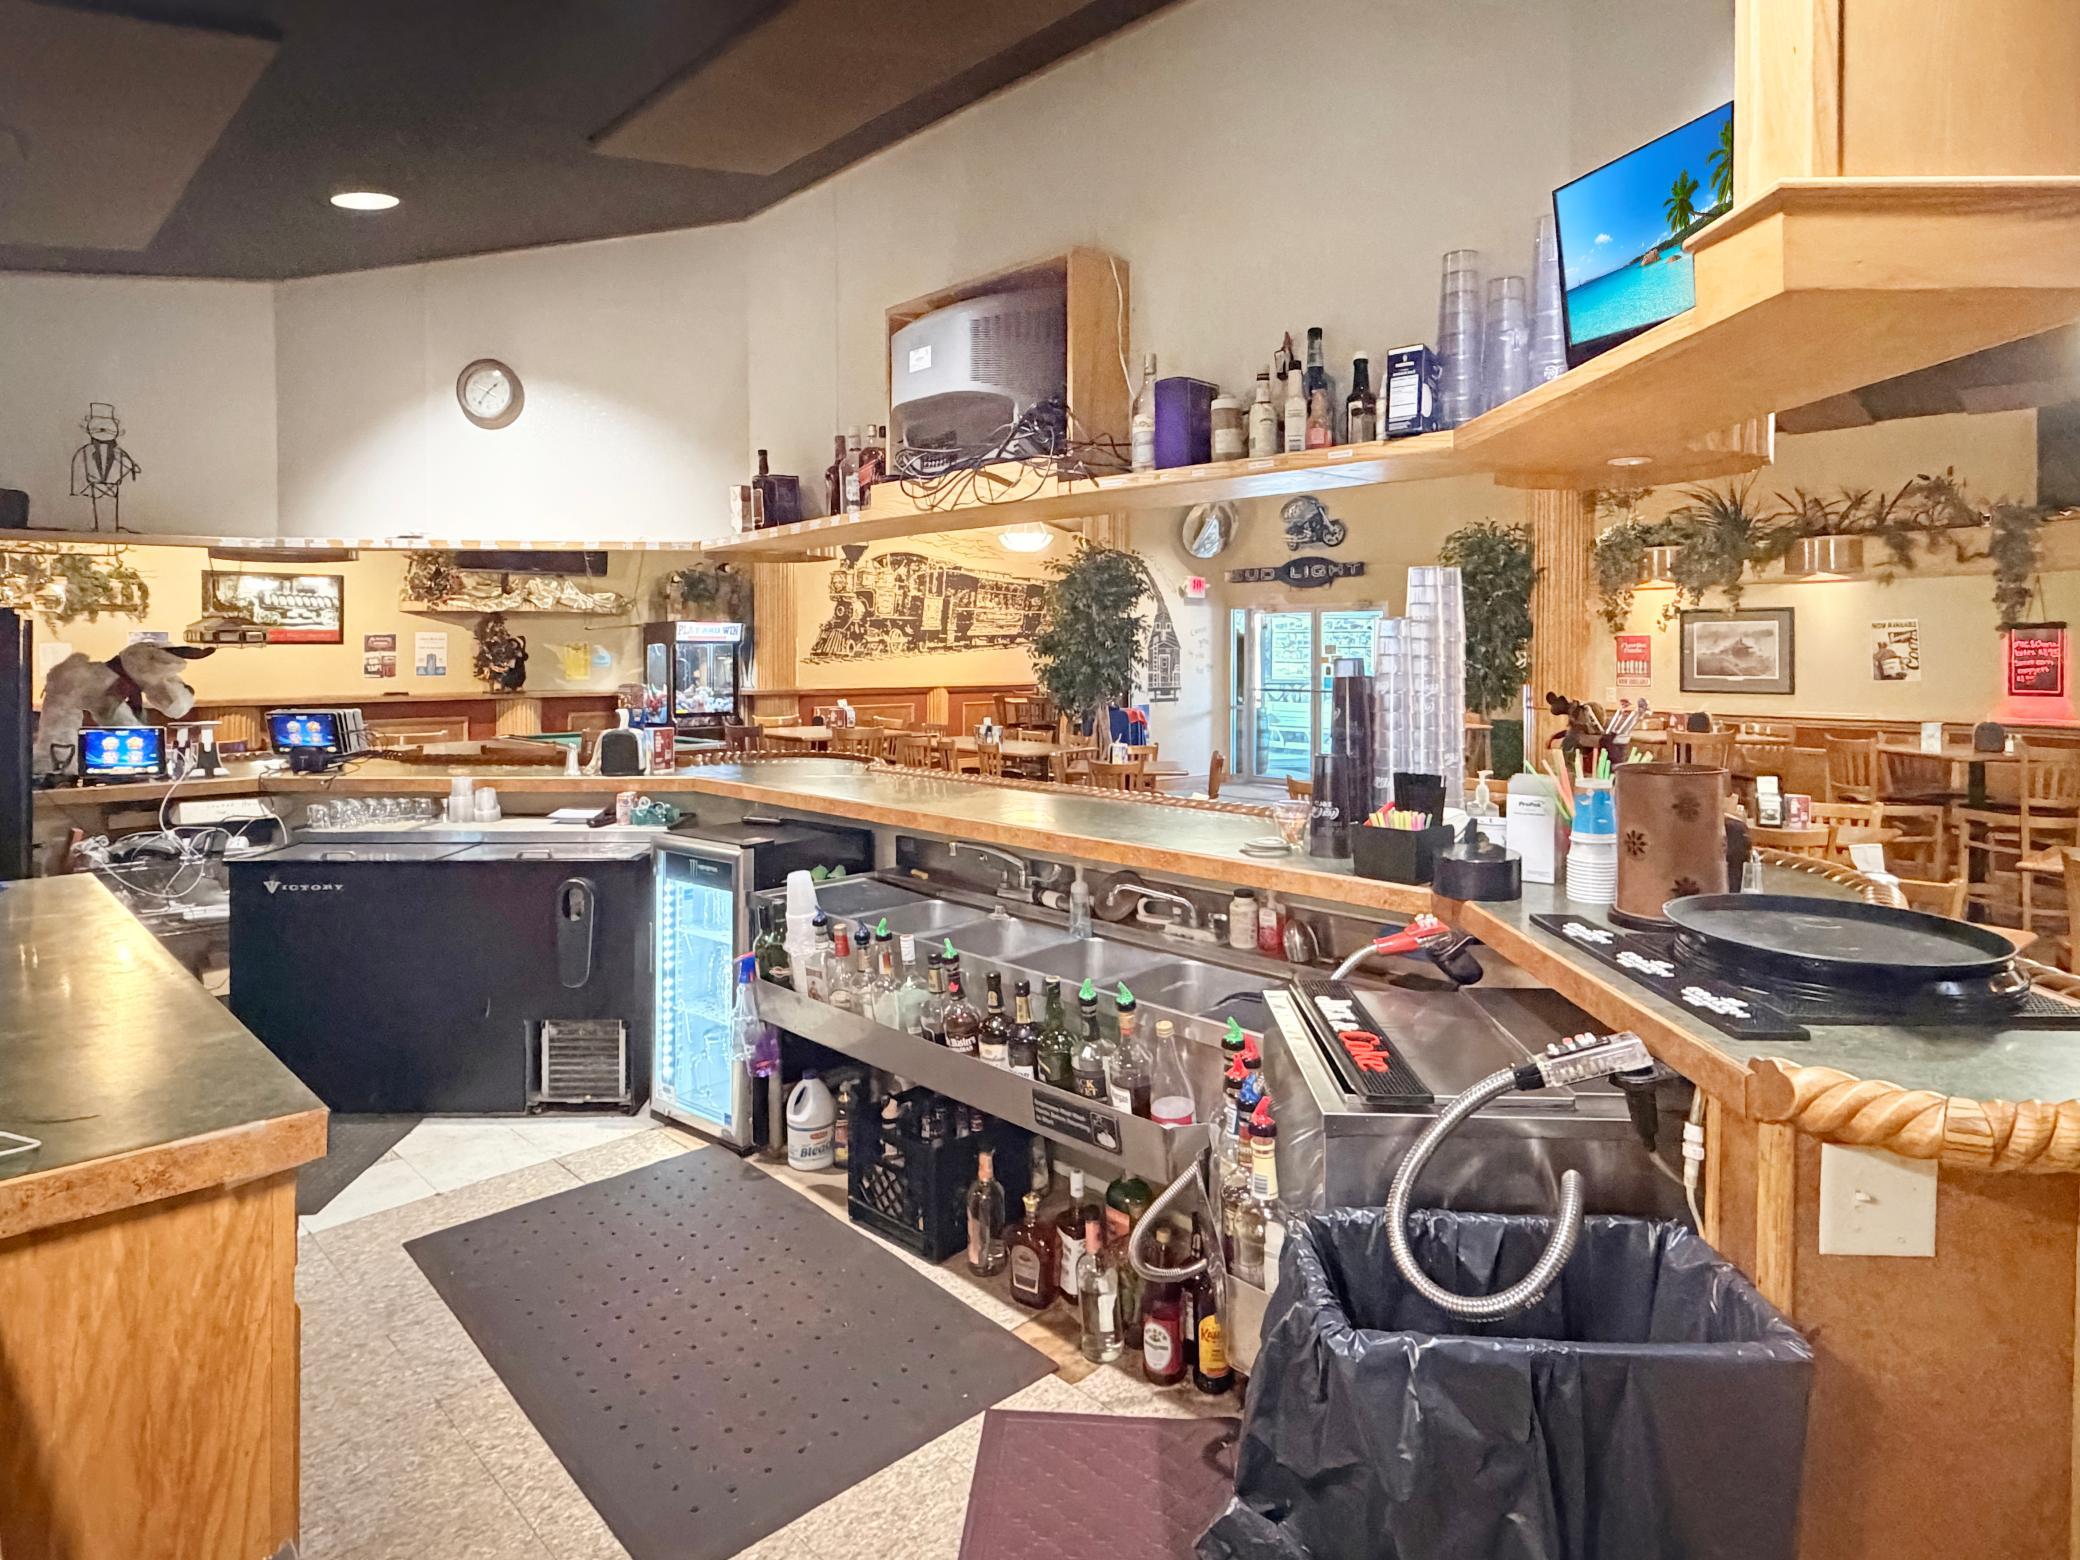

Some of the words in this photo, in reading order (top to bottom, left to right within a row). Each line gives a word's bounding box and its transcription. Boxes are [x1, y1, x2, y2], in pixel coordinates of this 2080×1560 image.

[1232, 568, 1275, 583] BUD
[1289, 562, 1361, 579] LIGHT
[263, 880, 344, 894] VICTORY
[1338, 1030, 1390, 1073] Coke
